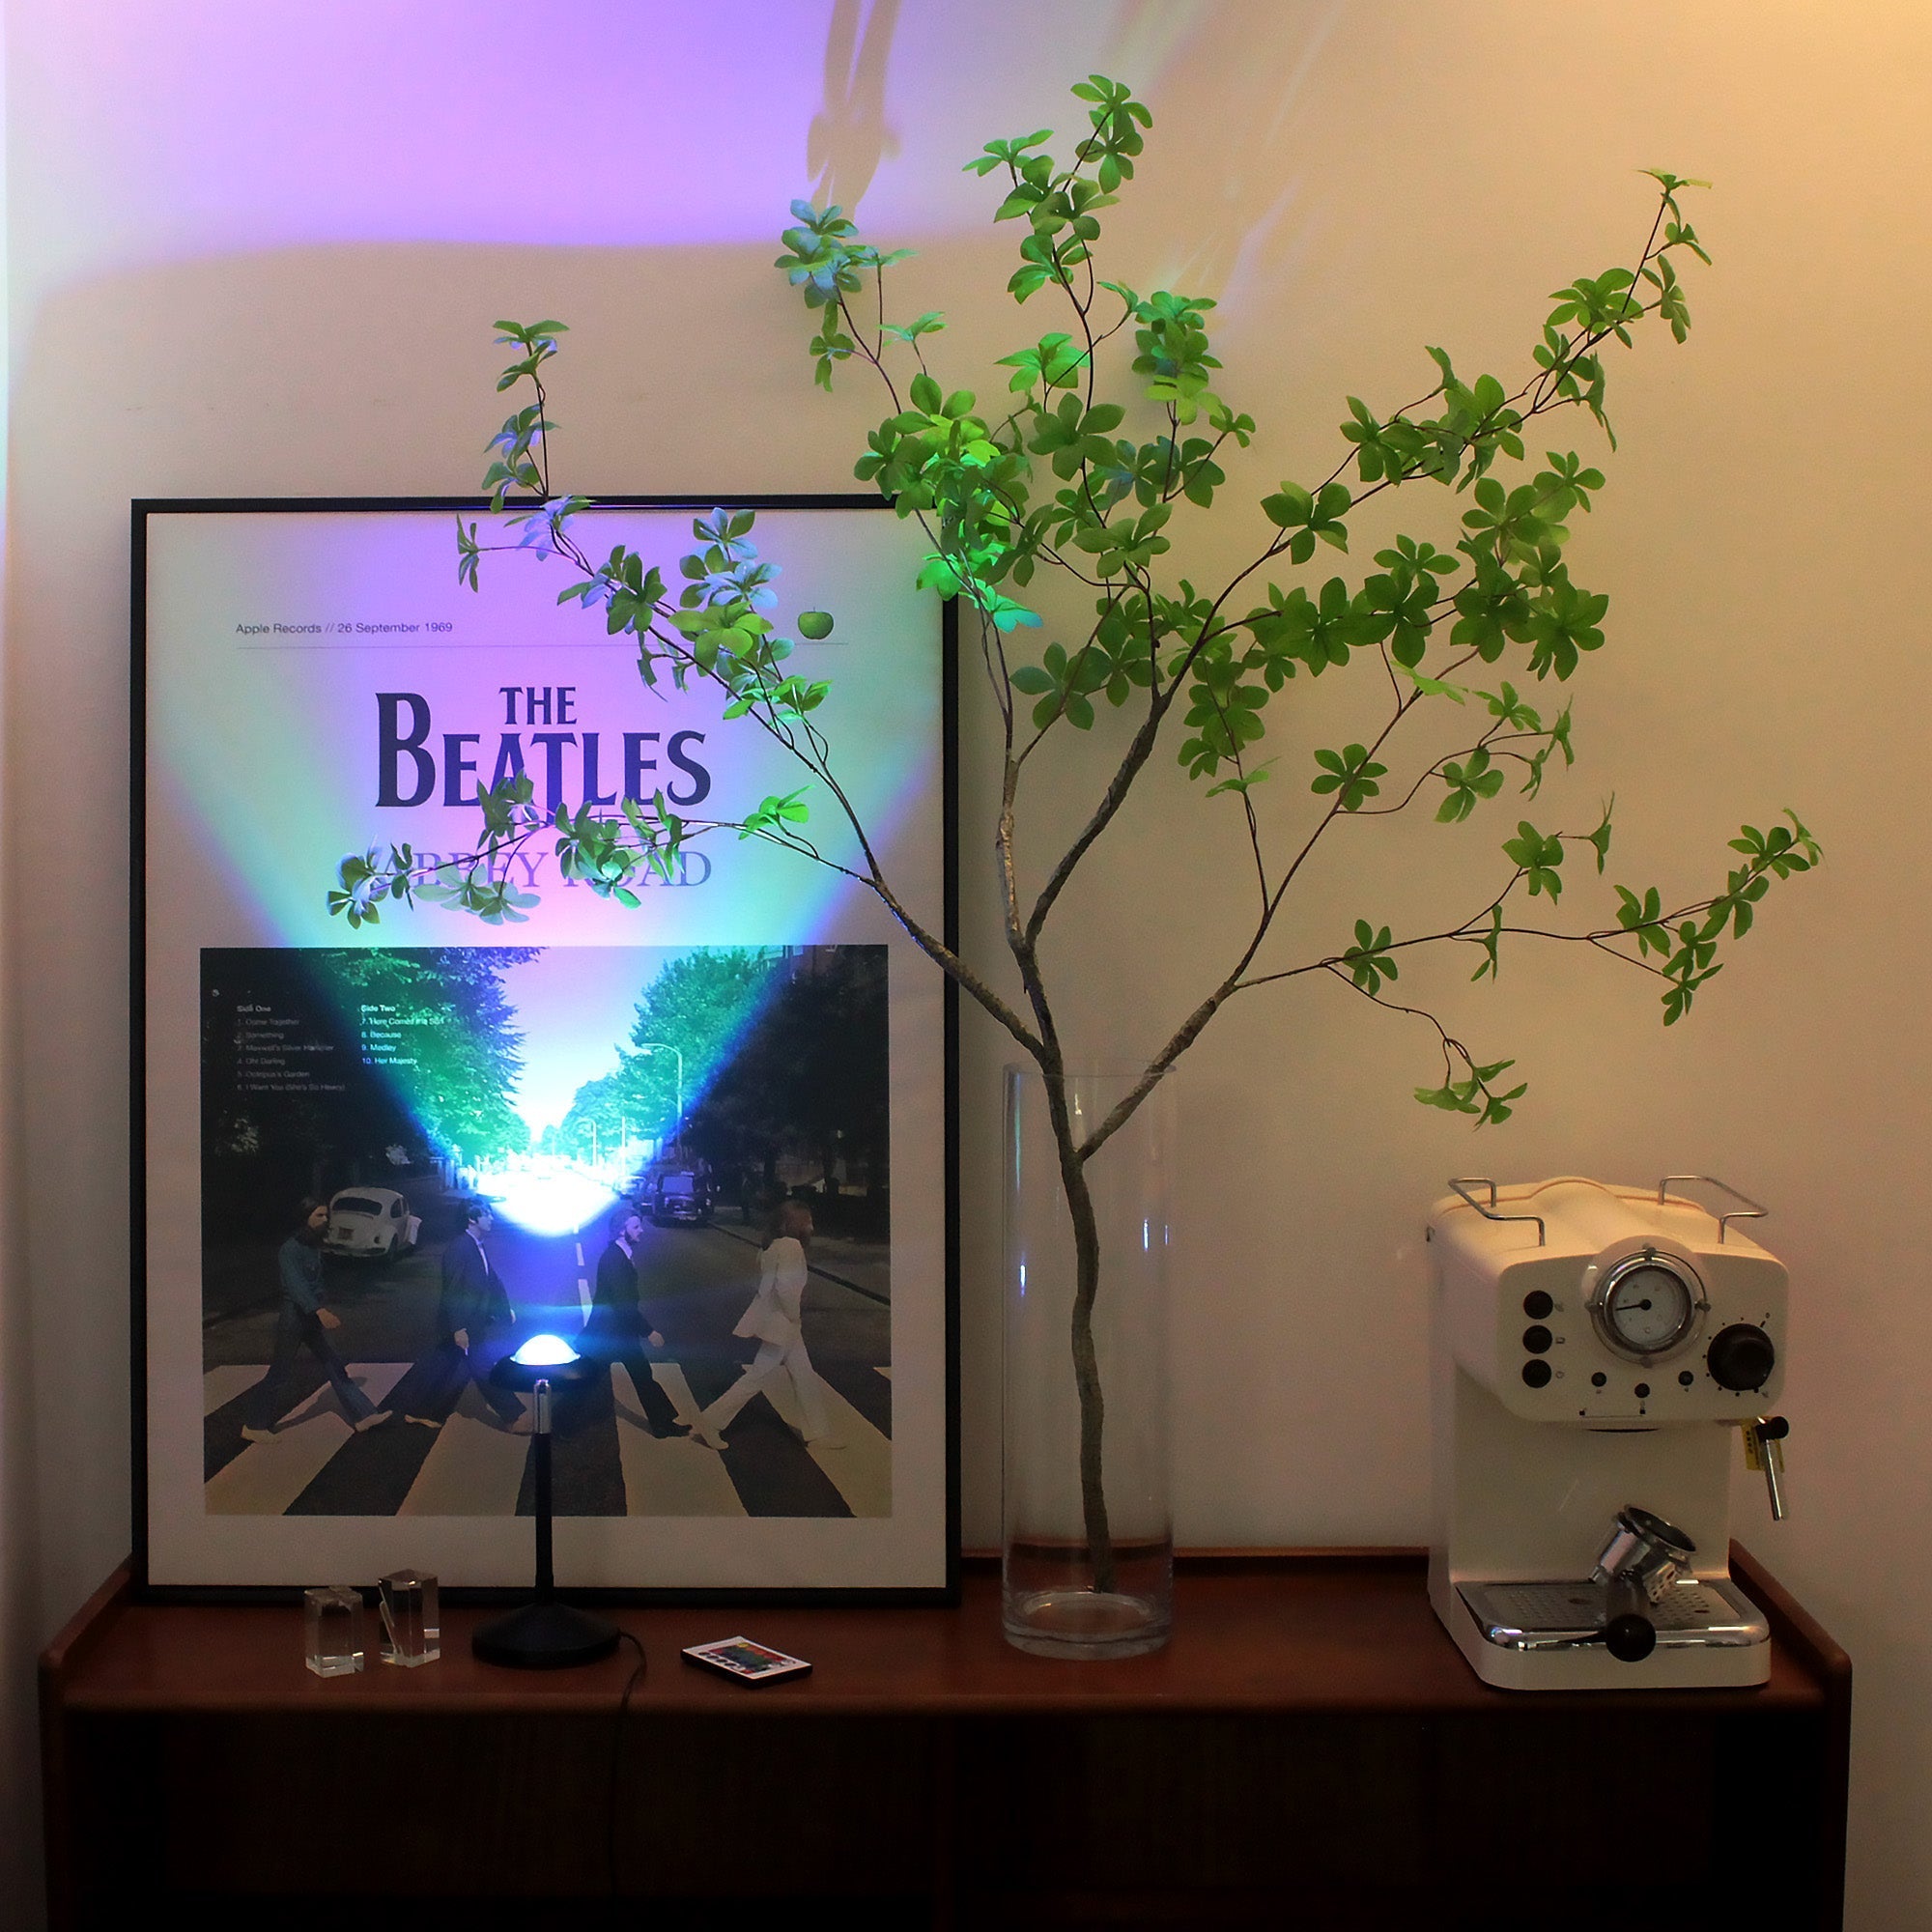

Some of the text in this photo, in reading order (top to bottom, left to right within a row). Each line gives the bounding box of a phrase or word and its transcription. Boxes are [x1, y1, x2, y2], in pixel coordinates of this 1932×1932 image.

[236, 623, 270, 636] Apple
[273, 623, 323, 634] Records
[337, 622, 353, 634] 26
[355, 622, 420, 635] September
[425, 622, 453, 633] 1969
[498, 686, 578, 725] THE
[370, 1030, 402, 1038] Because
[370, 1043, 396, 1052] Medley
[388, 1057, 417, 1066] Majesty
